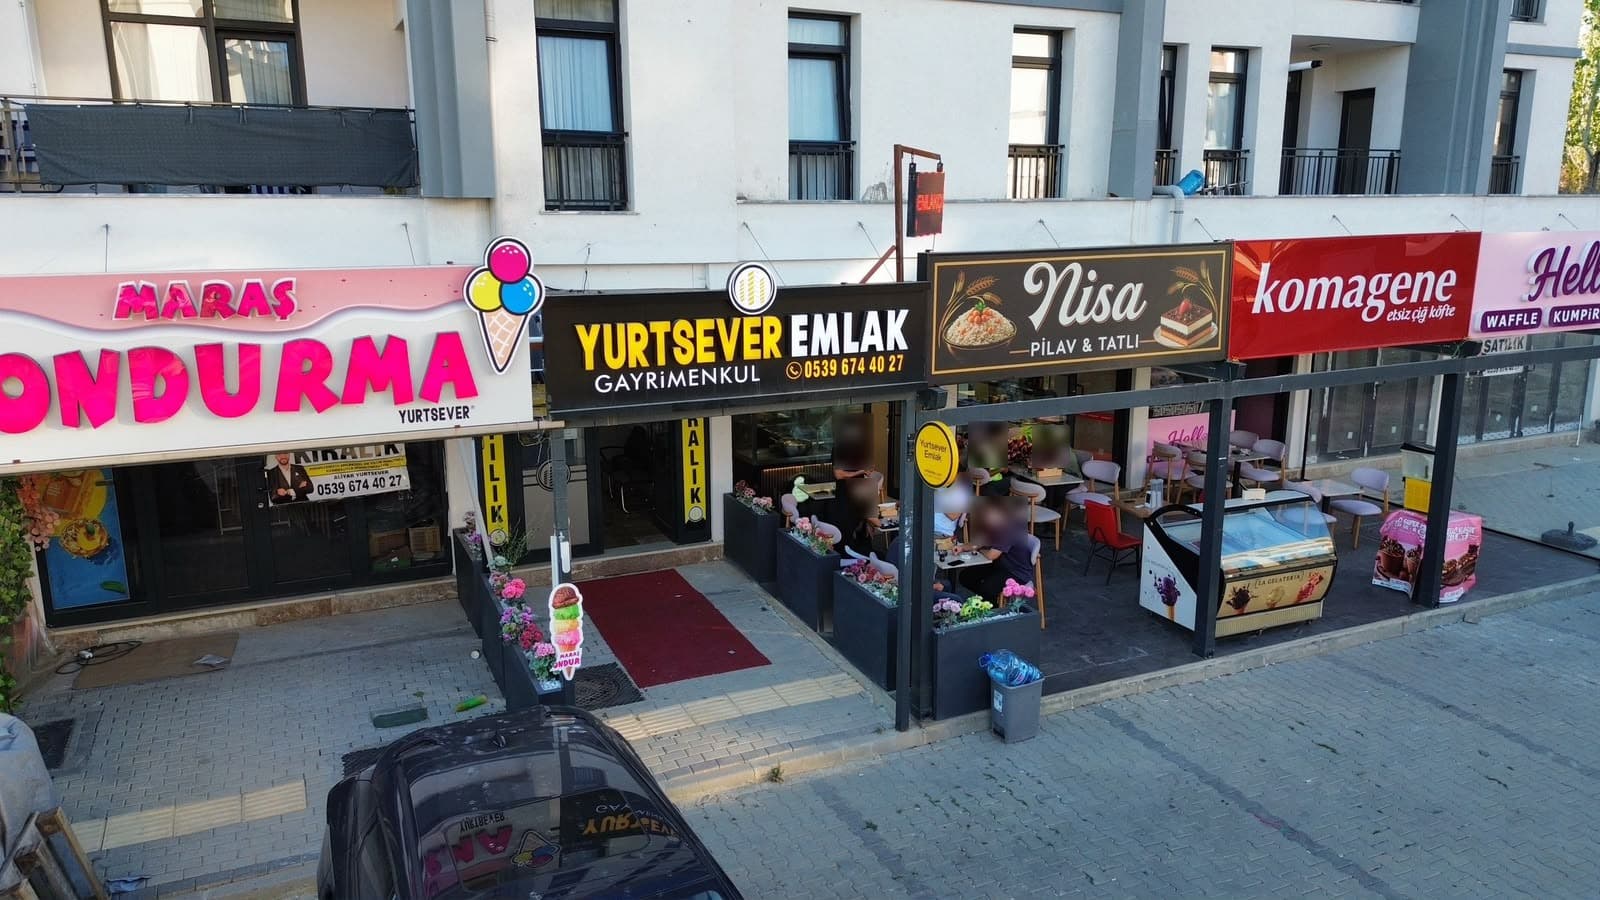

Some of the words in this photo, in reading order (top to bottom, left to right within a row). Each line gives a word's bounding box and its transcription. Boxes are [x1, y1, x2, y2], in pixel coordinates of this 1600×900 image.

[114, 278, 297, 321] MARAŞ
[1023, 262, 1148, 334] Nisa
[1251, 261, 1457, 322] komagene
[1386, 308, 1411, 321] etsiz
[1411, 306, 1429, 323] çiğ
[1428, 304, 1456, 320] köfte
[1486, 312, 1538, 328] WAFFLE
[574, 316, 783, 370] YURTSEVER
[791, 309, 910, 357] EMLAK
[1030, 337, 1077, 357] PİLAV
[1082, 337, 1093, 353] &
[1098, 334, 1139, 351] TATLI
[804, 359, 838, 378] 0539
[841, 357, 865, 375] 674
[869, 355, 885, 373] 40
[888, 354, 904, 372] 27
[398, 405, 470, 424] YURTSEVER
[317, 482, 345, 496] 0539
[349, 479, 369, 492] 674
[373, 477, 386, 488] 40
[389, 475, 402, 487] 27
